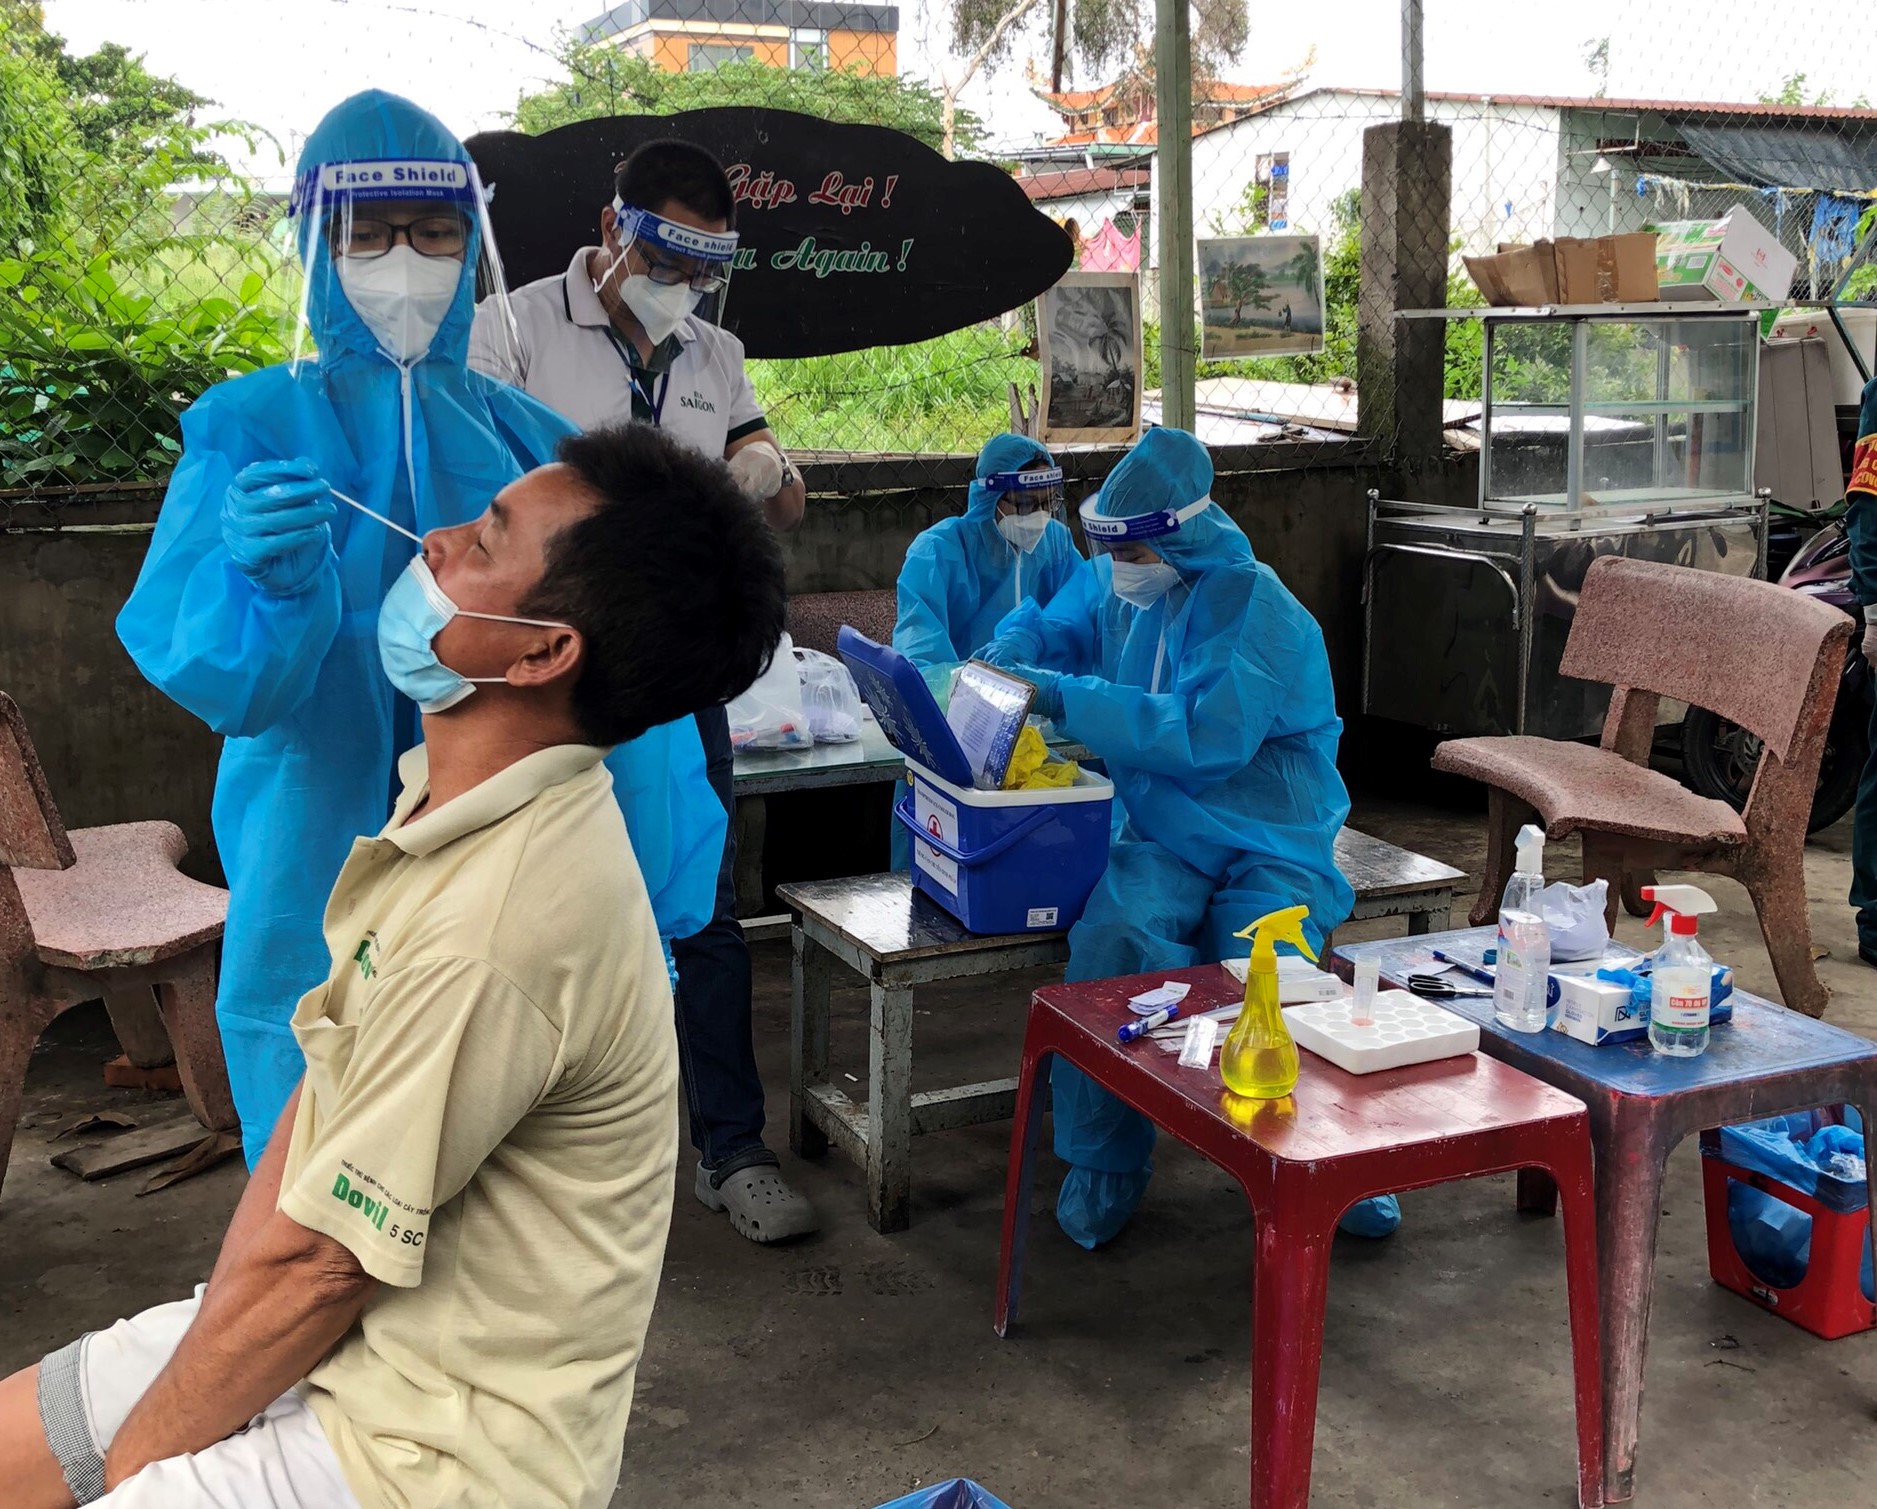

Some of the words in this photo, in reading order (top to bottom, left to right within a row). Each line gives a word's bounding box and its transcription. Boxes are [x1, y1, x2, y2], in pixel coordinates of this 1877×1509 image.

[335, 169, 383, 185] Face
[393, 167, 456, 183] Shield
[351, 190, 389, 199] Protective
[390, 189, 425, 198] Isolation
[426, 189, 445, 198] Mask
[808, 171, 875, 215] Lại
[881, 174, 899, 208] !
[668, 229, 699, 246] Face
[771, 236, 890, 279] Again
[897, 238, 914, 272] !
[680, 396, 715, 414] SAIGON
[1088, 523, 1119, 534] Shield
[332, 1172, 389, 1232] Dovil
[389, 1224, 400, 1239] 5
[401, 1230, 424, 1247] SC
